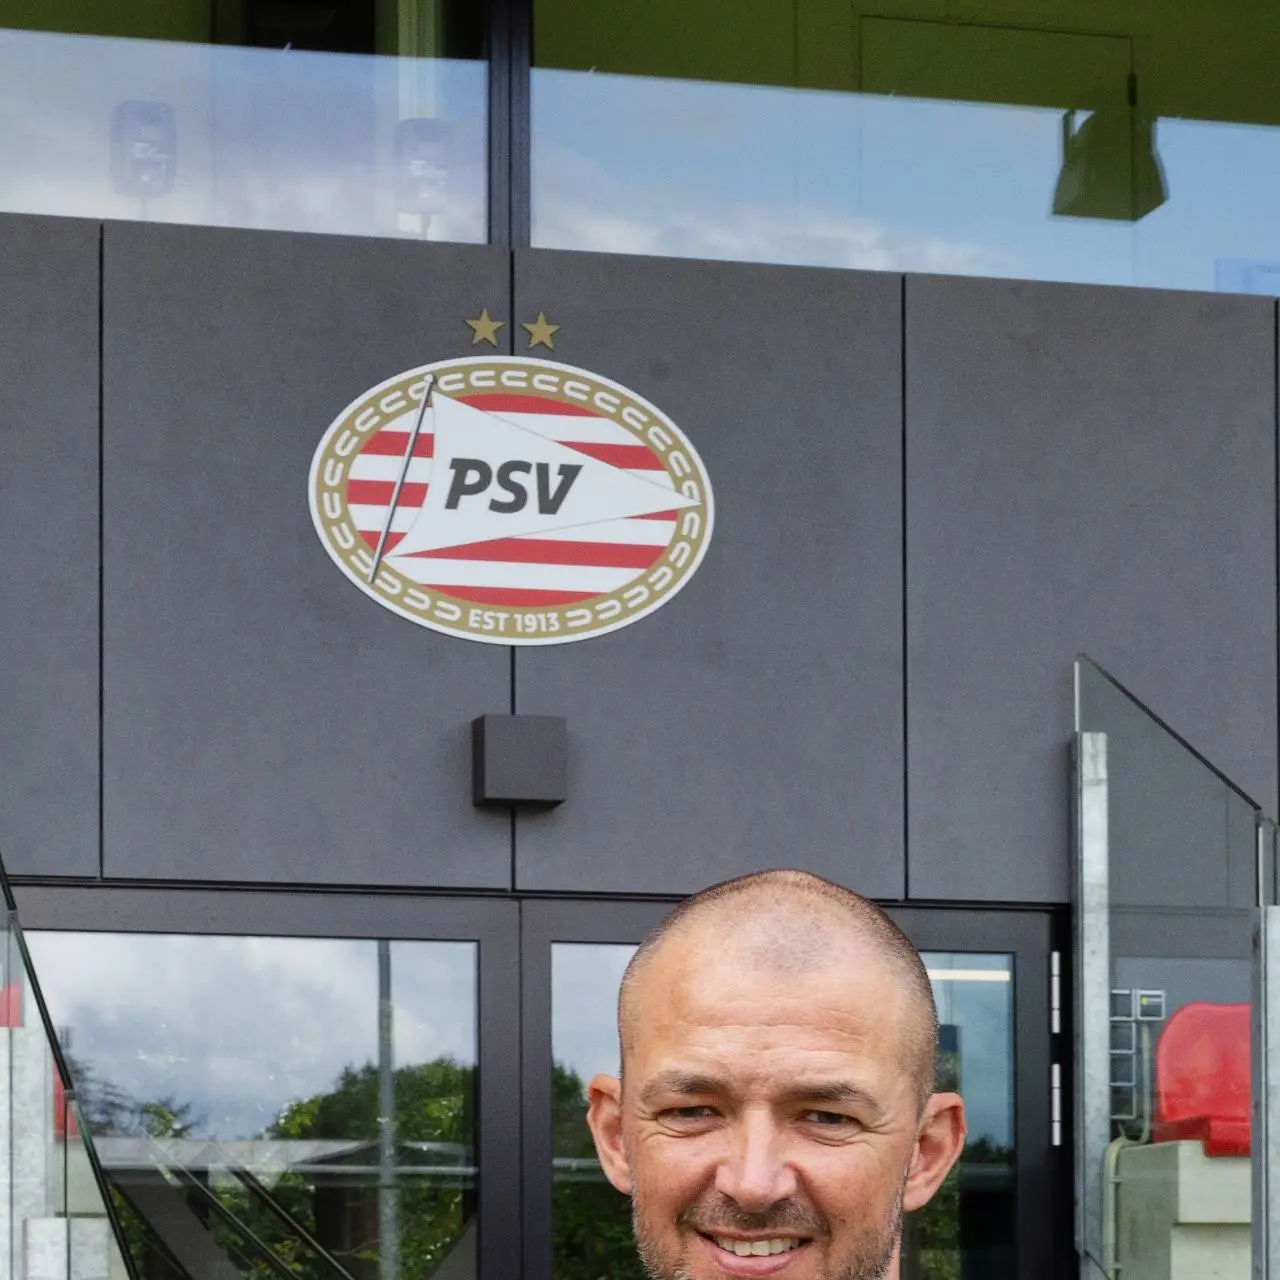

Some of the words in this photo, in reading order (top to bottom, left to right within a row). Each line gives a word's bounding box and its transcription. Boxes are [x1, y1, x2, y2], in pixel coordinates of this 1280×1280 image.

[444, 457, 584, 515] PSV
[468, 608, 509, 632] EST
[514, 612, 560, 633] 1913
